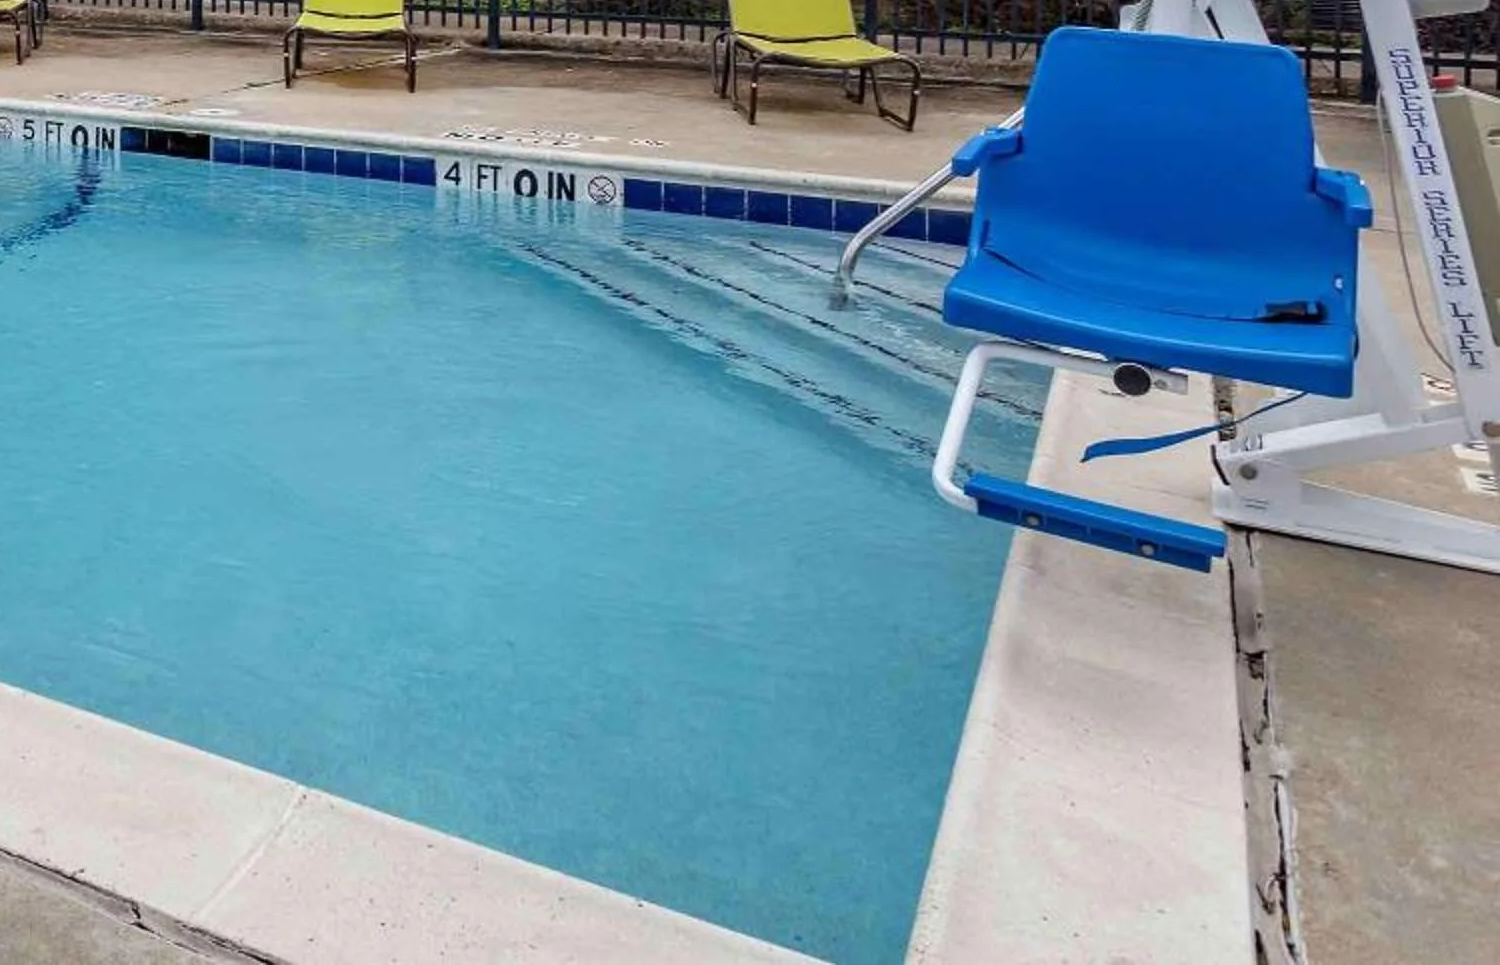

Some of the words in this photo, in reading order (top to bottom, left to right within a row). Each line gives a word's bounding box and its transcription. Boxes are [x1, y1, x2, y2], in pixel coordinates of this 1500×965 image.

[22, 119, 35, 140] 5
[45, 121, 64, 145] FT
[95, 126, 115, 149] IN
[444, 161, 461, 186] 4
[477, 163, 502, 191] FT
[548, 171, 575, 201] IN
[1388, 48, 1442, 176] SUPERIOR
[1422, 190, 1468, 287] SERIES
[1450, 302, 1484, 369] LIFT
